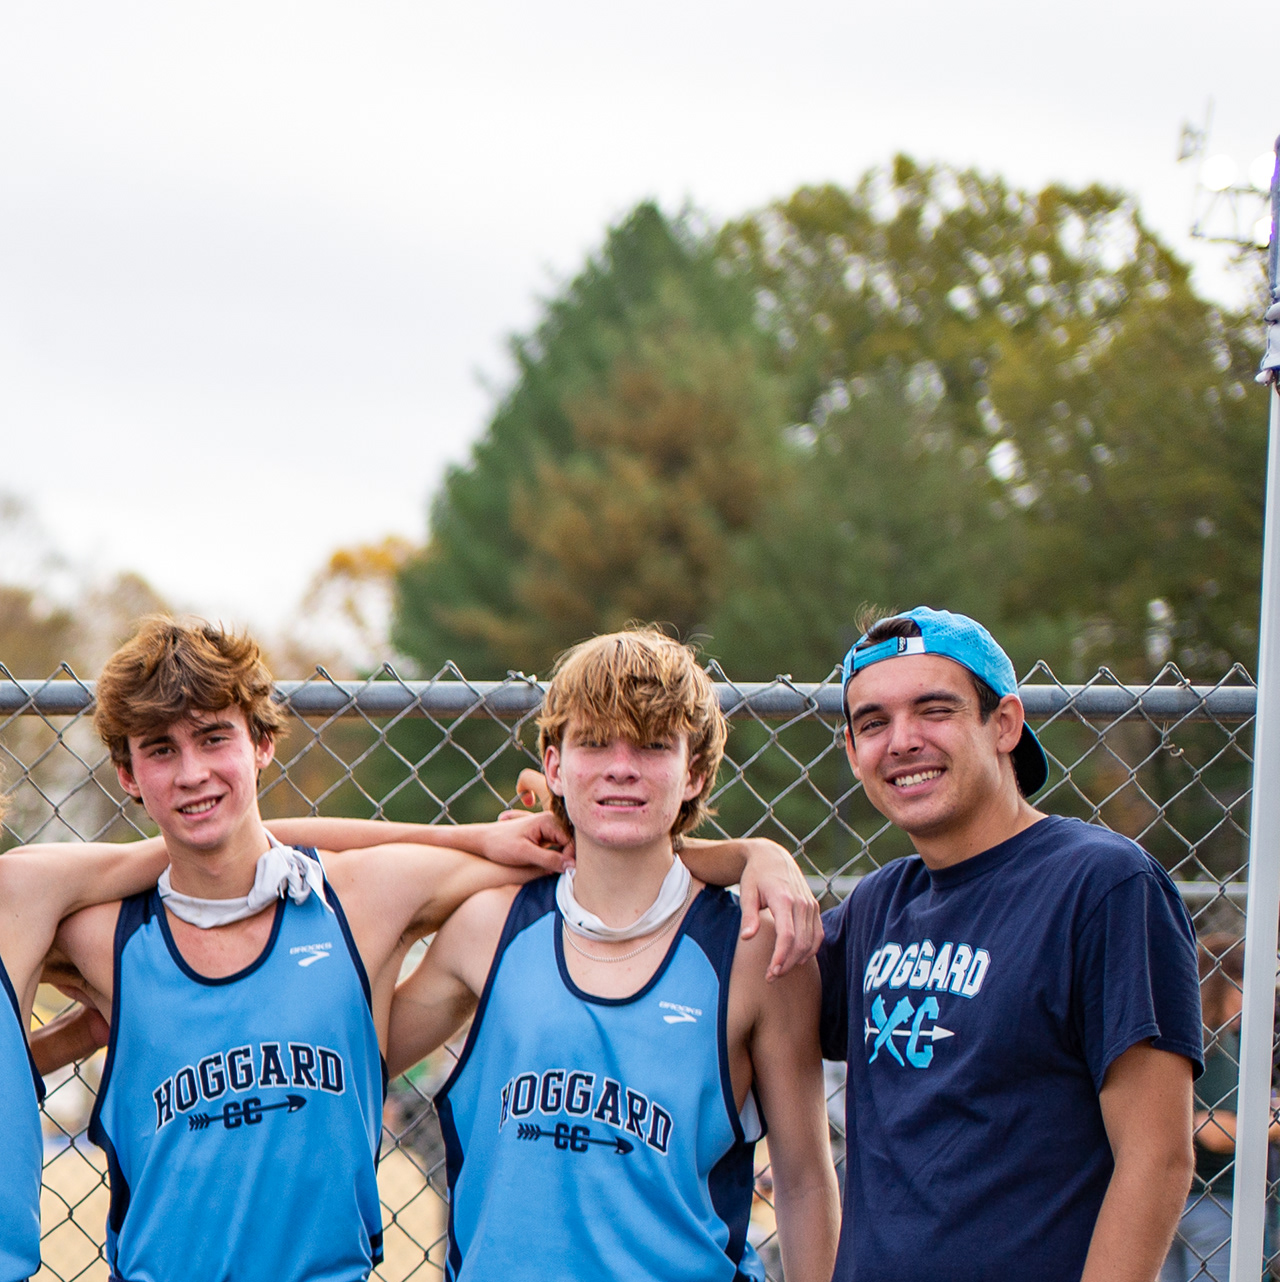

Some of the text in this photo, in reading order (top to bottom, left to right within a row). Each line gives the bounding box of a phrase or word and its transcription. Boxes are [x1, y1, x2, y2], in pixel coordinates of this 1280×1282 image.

[290, 942, 332, 954] BROOKS
[863, 939, 991, 999] HOGGARD
[659, 1001, 702, 1016] BROOKS
[152, 1041, 346, 1134] HOGGARD
[223, 1097, 262, 1130] CC
[554, 1122, 590, 1152] CC
